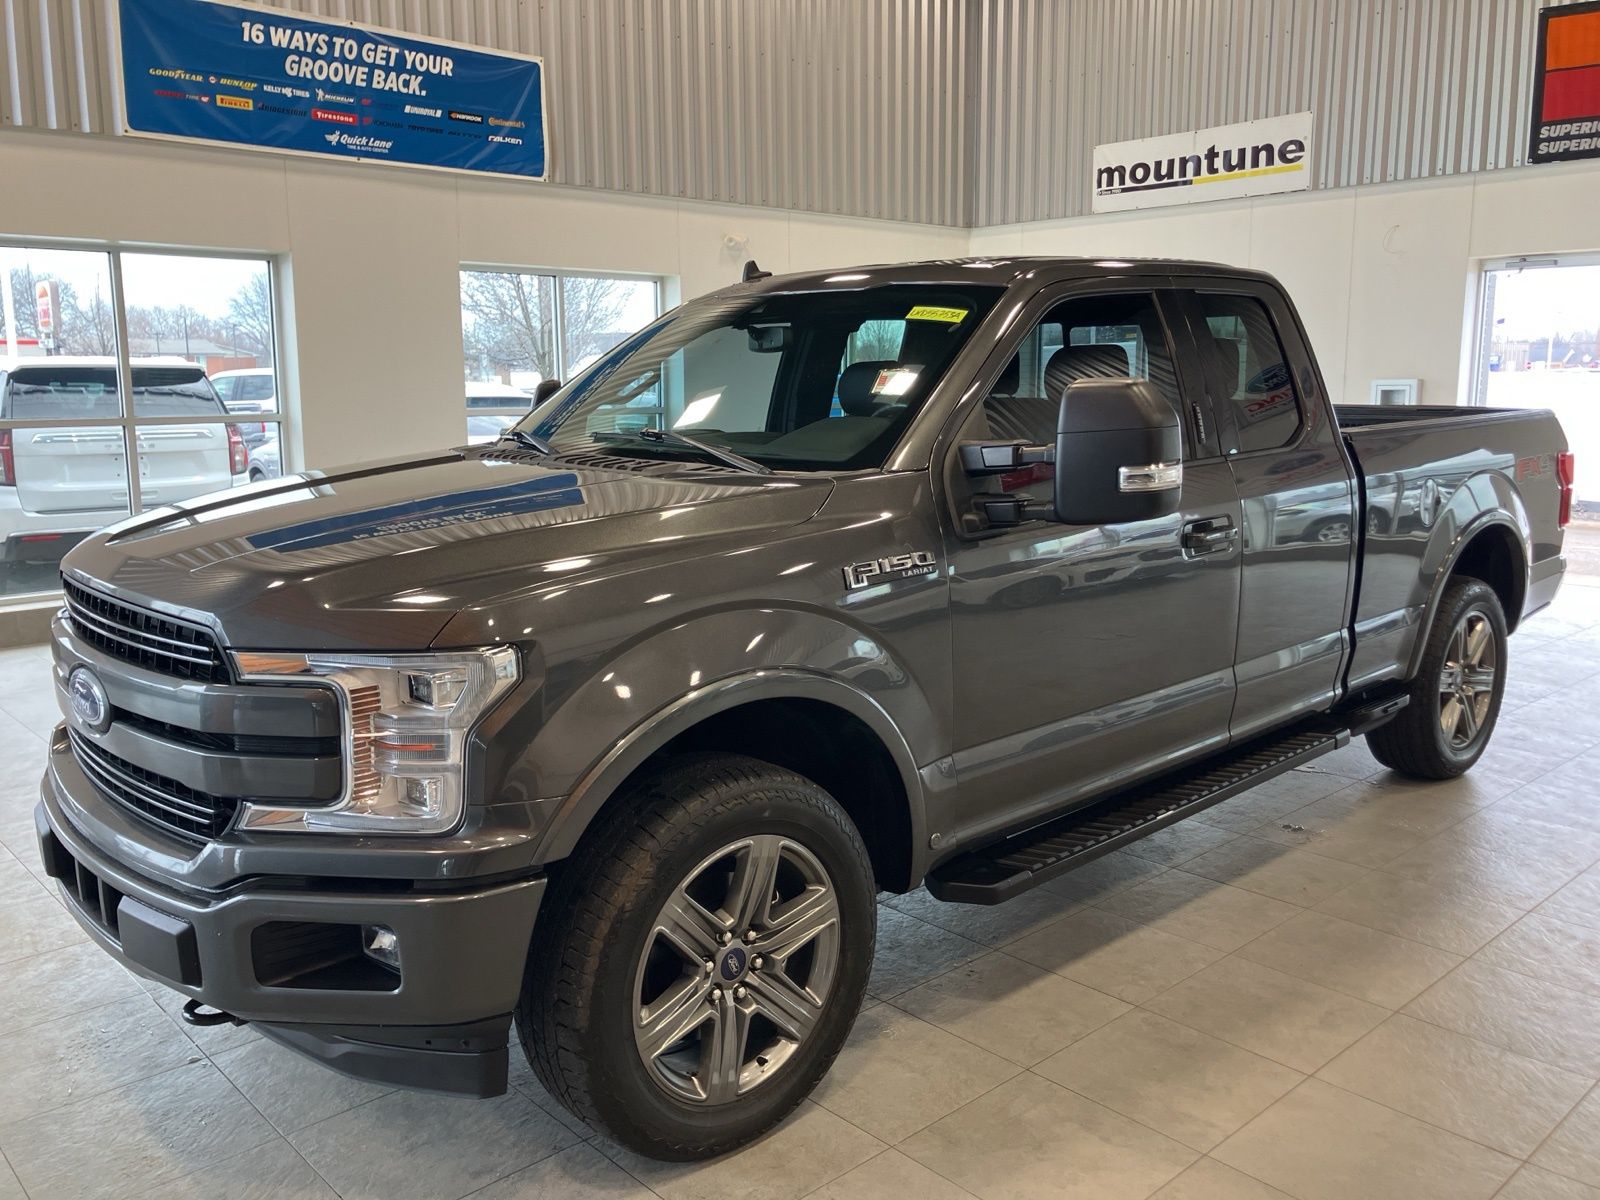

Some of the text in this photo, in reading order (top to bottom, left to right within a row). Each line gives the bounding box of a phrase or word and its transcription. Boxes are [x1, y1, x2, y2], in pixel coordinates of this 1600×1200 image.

[241, 22, 454, 77] 16 WAYS TO GET YOUR
[149, 68, 203, 82] GOODYEAR
[284, 54, 427, 97] GROOVE BACK.
[220, 78, 258, 91] DUNLOP
[263, 84, 282, 94] KELLY
[324, 94, 355, 104] MICHELIN
[316, 111, 354, 123] Firestone
[1539, 121, 1600, 139] SUPERI
[340, 134, 393, 149] Quick Lane
[488, 135, 522, 145] FALKEN
[1096, 139, 1306, 189] mountune
[902, 566, 934, 577] LARIAT
